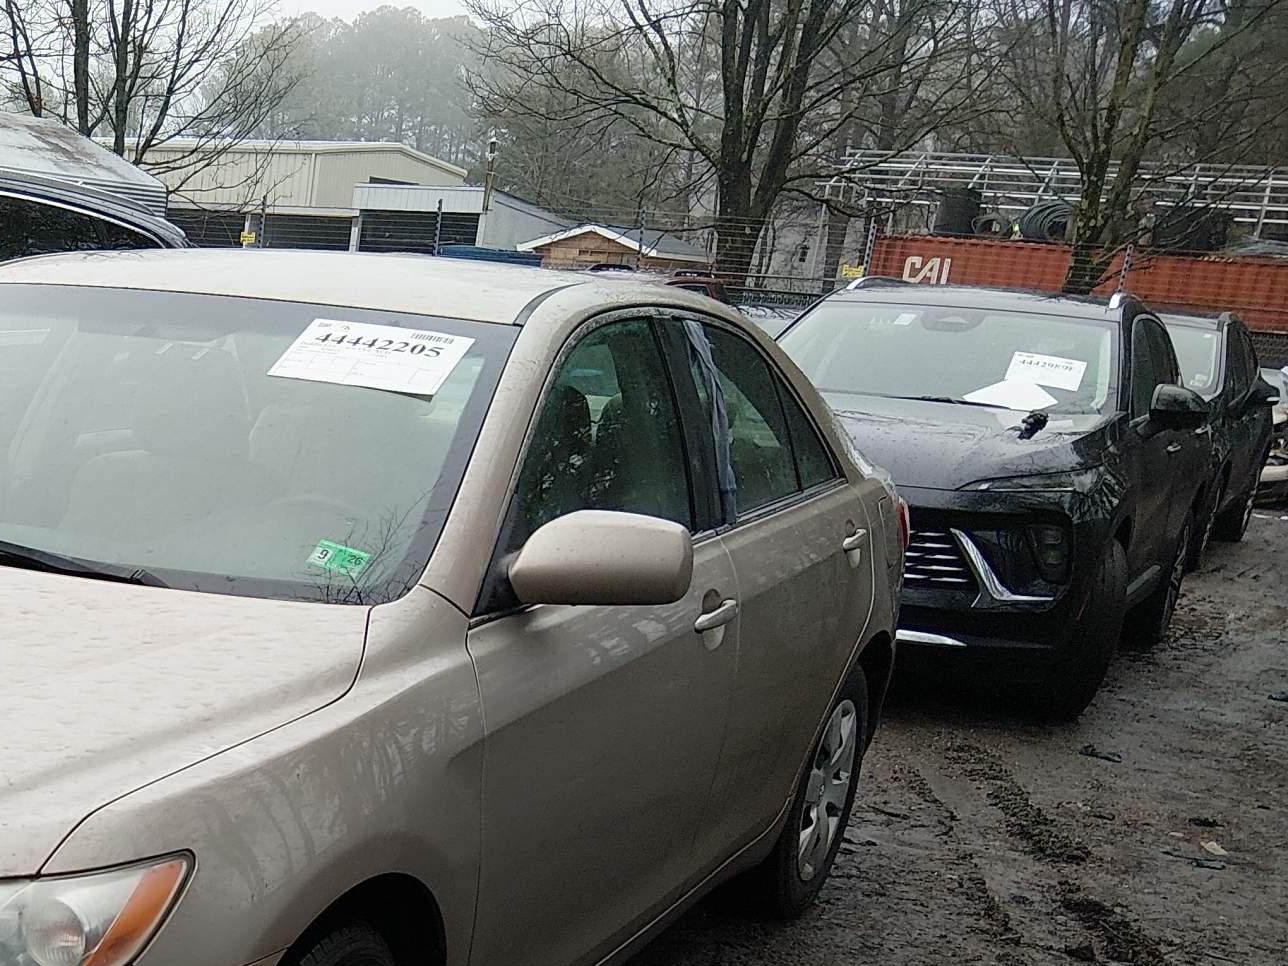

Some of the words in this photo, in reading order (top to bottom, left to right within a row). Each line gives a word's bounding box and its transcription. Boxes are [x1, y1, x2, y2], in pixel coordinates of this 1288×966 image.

[902, 256, 952, 285] CAI
[315, 332, 445, 358] 44442205
[318, 549, 329, 560] 9
[347, 554, 364, 566] 26
